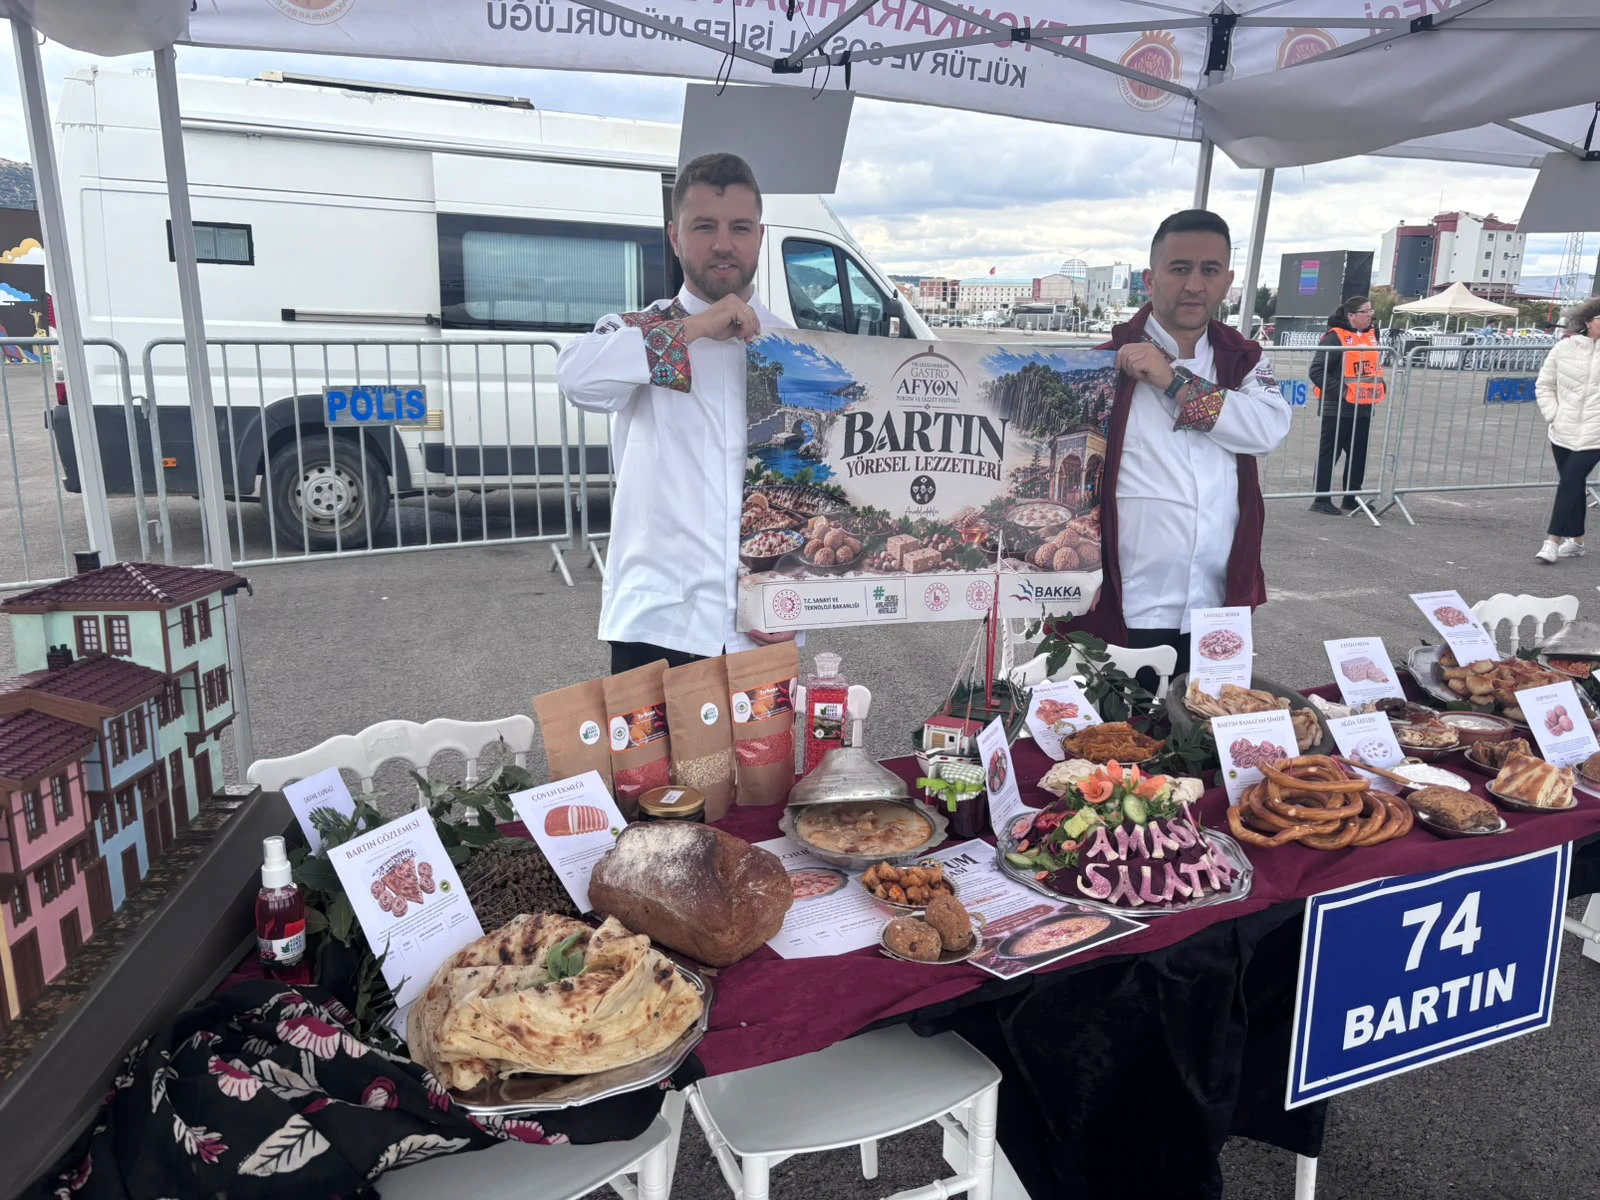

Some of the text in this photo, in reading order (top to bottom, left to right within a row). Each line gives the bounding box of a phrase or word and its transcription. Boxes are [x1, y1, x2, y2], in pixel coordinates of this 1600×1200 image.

[897, 378, 959, 396] AFYON
[911, 368, 949, 379] GASTRO
[840, 410, 1010, 461] BARTIN
[846, 455, 1002, 481] YÖRESEL LEZZETLERİ
[1034, 586, 1082, 598] BAKKA
[345, 818, 420, 859] BARTIN GÖZLEMESİ
[1402, 891, 1482, 972] 74
[1343, 962, 1516, 1050] BARTIN
